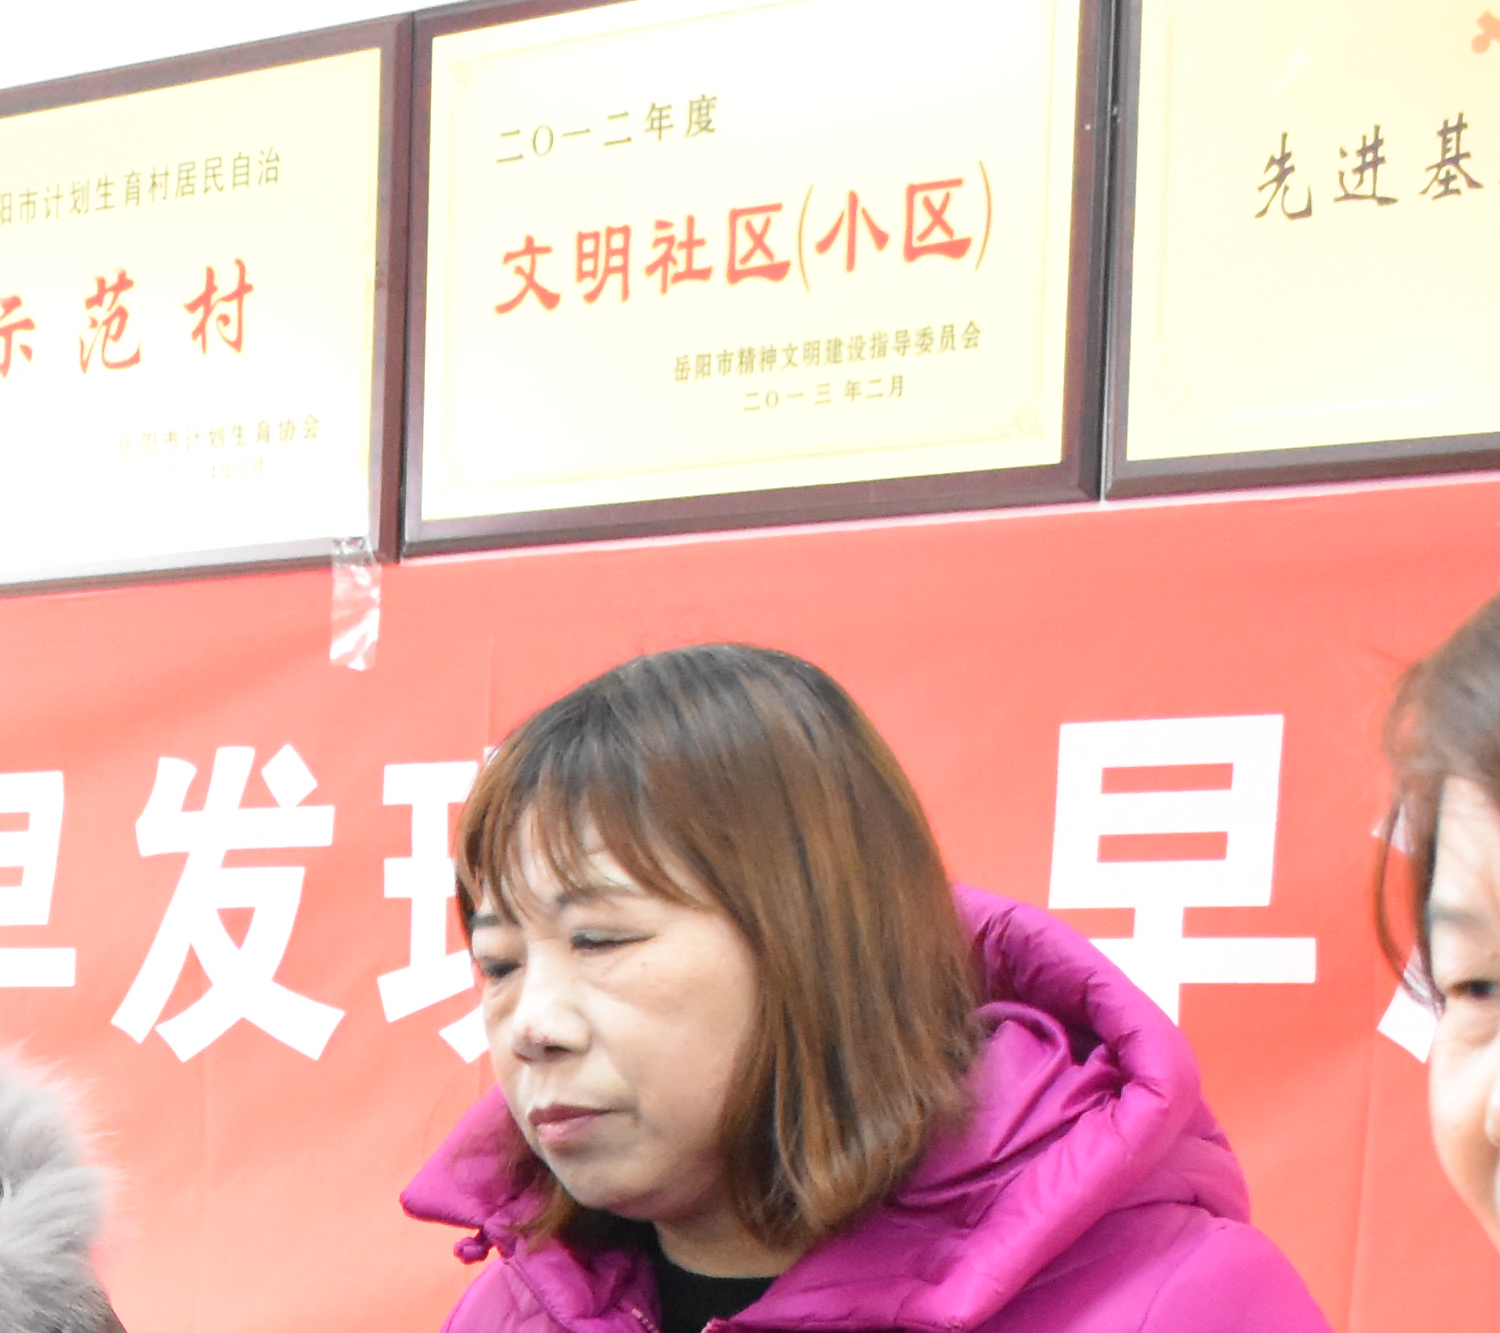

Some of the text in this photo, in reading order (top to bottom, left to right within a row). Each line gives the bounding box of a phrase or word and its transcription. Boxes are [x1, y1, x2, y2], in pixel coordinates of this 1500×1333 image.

[673, 320, 982, 383] 岳阳市精神文明建设指导委员会
